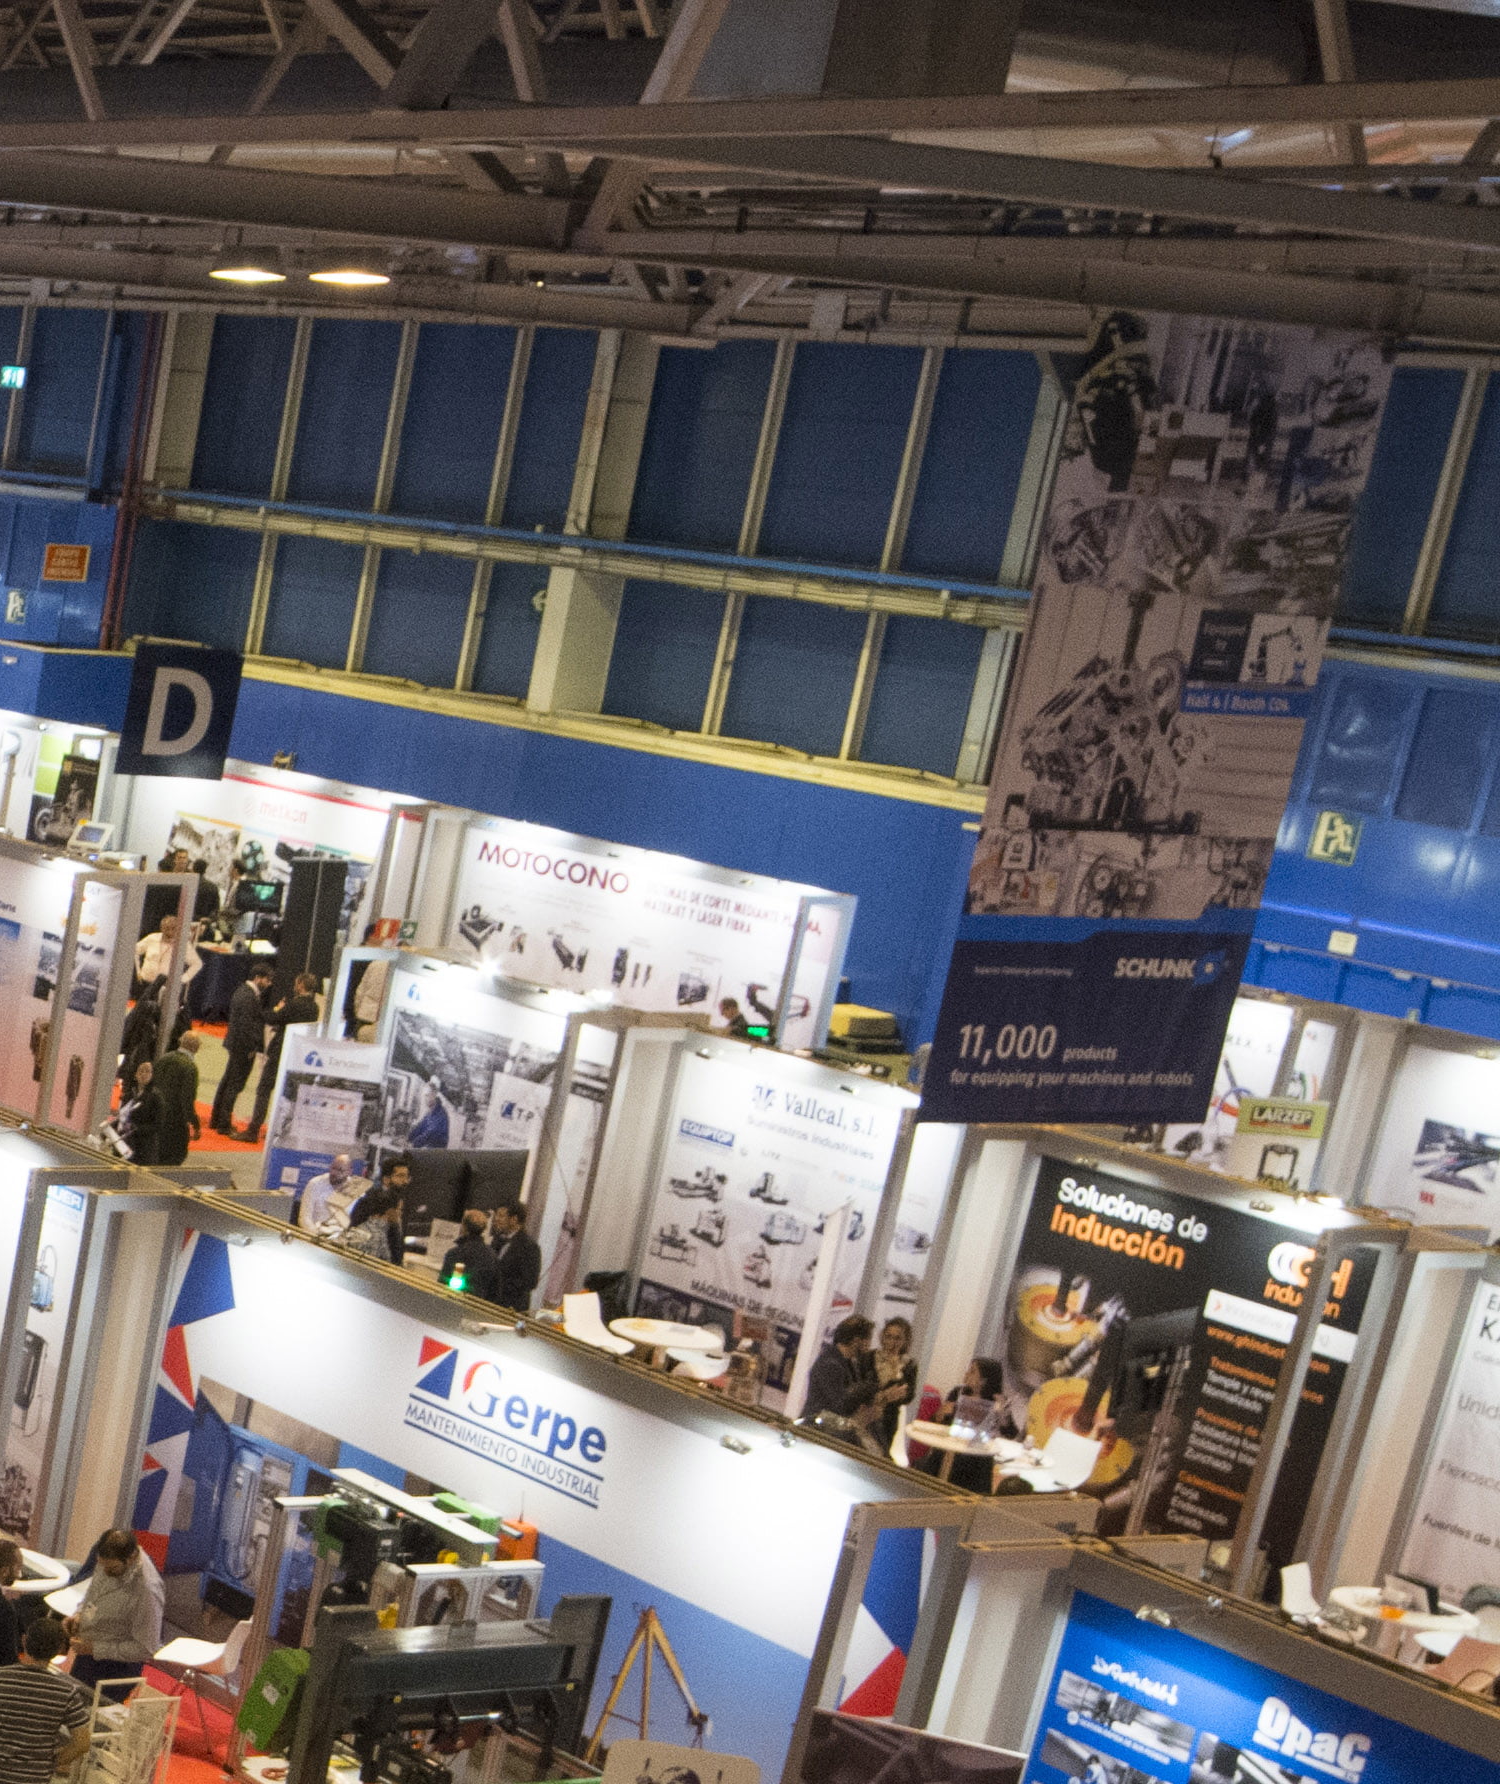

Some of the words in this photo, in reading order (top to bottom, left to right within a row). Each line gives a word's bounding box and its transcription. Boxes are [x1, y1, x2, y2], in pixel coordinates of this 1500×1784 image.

[140, 666, 216, 758] D
[477, 840, 631, 896] MOTOCONO
[1114, 957, 1197, 980] SCHUNK
[958, 1023, 1058, 1066] 11,000
[1062, 1045, 1118, 1063] products
[950, 1070, 969, 1084] for
[971, 1071, 1037, 1089] equipping
[1038, 1072, 1065, 1088] your
[1067, 1070, 1126, 1087] machines
[1128, 1071, 1152, 1087] and
[1155, 1070, 1194, 1087] robots
[783, 1091, 847, 1134] Vallcal,
[1253, 1104, 1314, 1126] LARZEP
[1049, 1203, 1186, 1271] Inducción
[1057, 1176, 1175, 1236] Soluciones
[1176, 1205, 1209, 1243] de
[462, 1360, 607, 1464] Gerpe
[405, 1402, 518, 1465] MANTENIMIENTO
[520, 1453, 601, 1502] INDUSTRIAL
